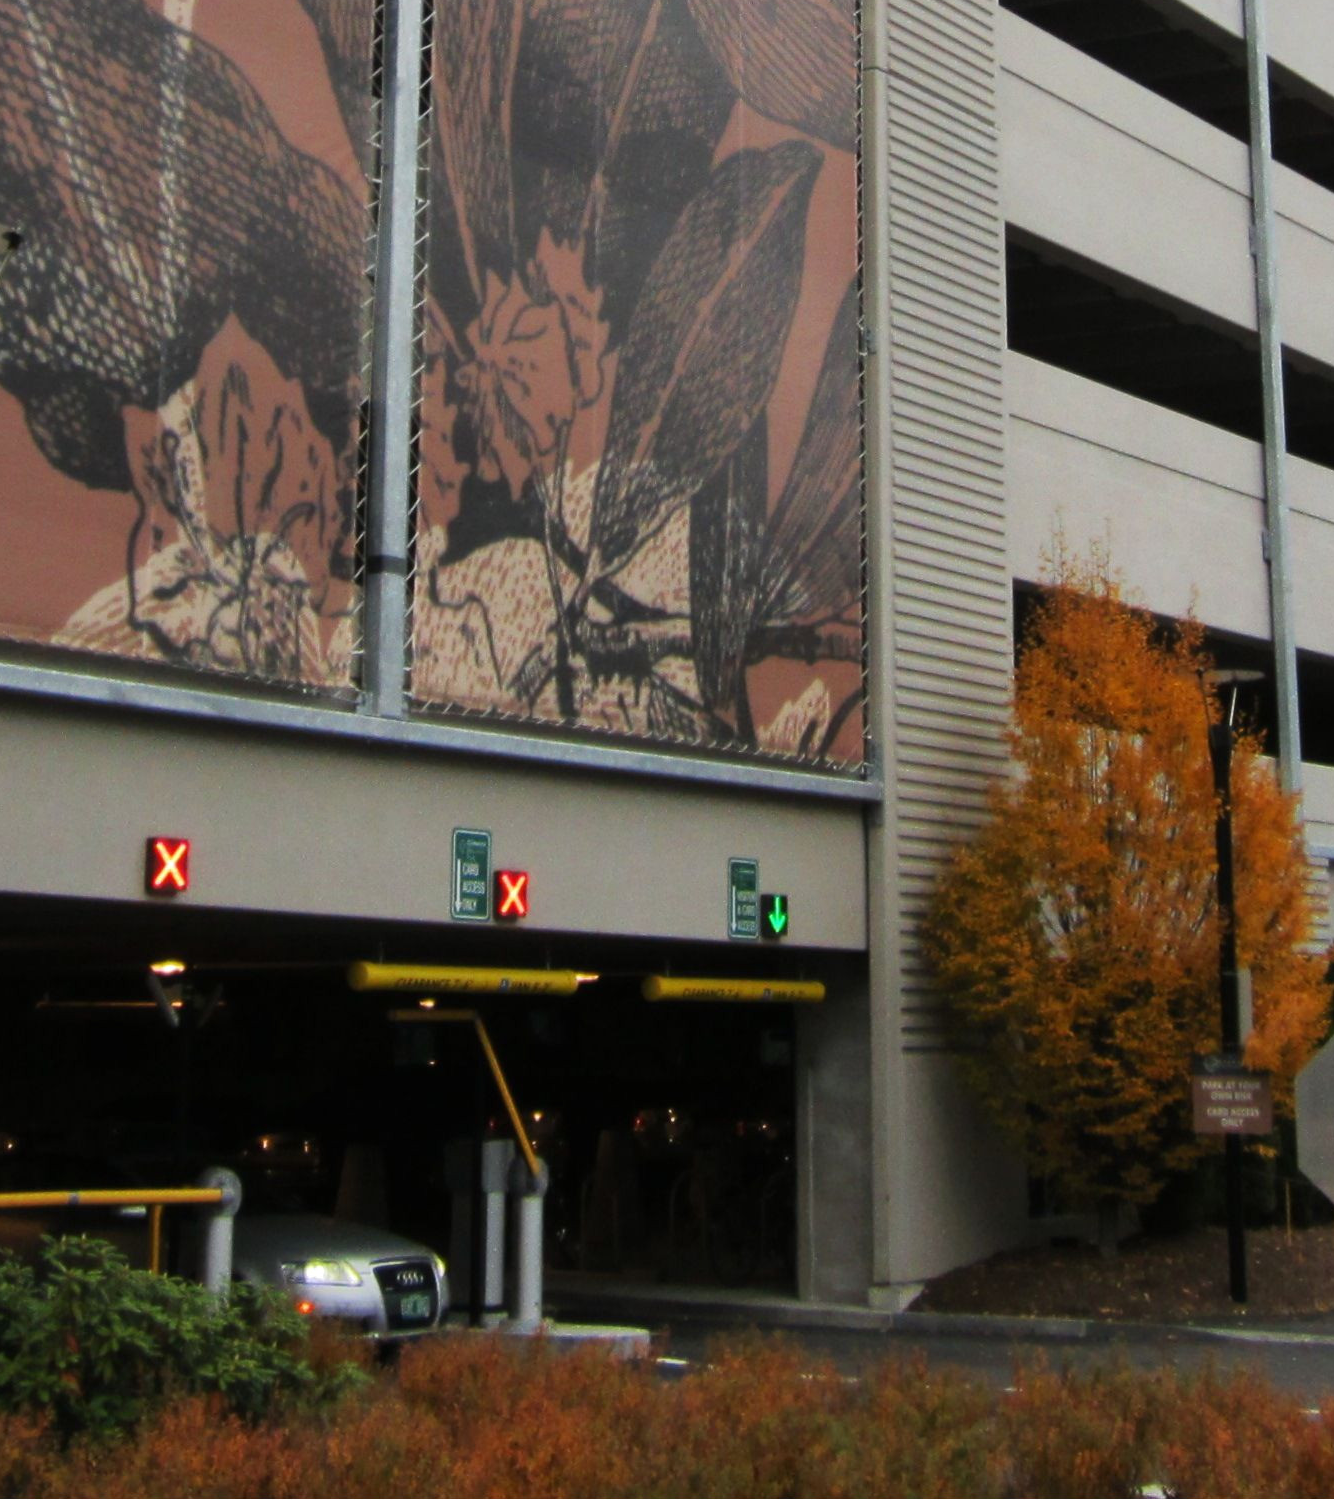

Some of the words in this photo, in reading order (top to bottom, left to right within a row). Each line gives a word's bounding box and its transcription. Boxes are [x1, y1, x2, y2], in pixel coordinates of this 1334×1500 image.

[462, 863, 479, 877] CARD
[462, 880, 486, 895] ACCESS
[462, 898, 477, 912] ONLY
[395, 977, 451, 989] CLEARANCE
[1202, 1080, 1223, 1090] PARK
[1225, 1080, 1235, 1090] AT
[1238, 1081, 1260, 1090] YOUR
[1211, 1092, 1233, 1101] OWN
[1207, 1107, 1229, 1116] CARD
[1230, 1107, 1260, 1117] ACCESS
[1221, 1117, 1244, 1127] ONLY
